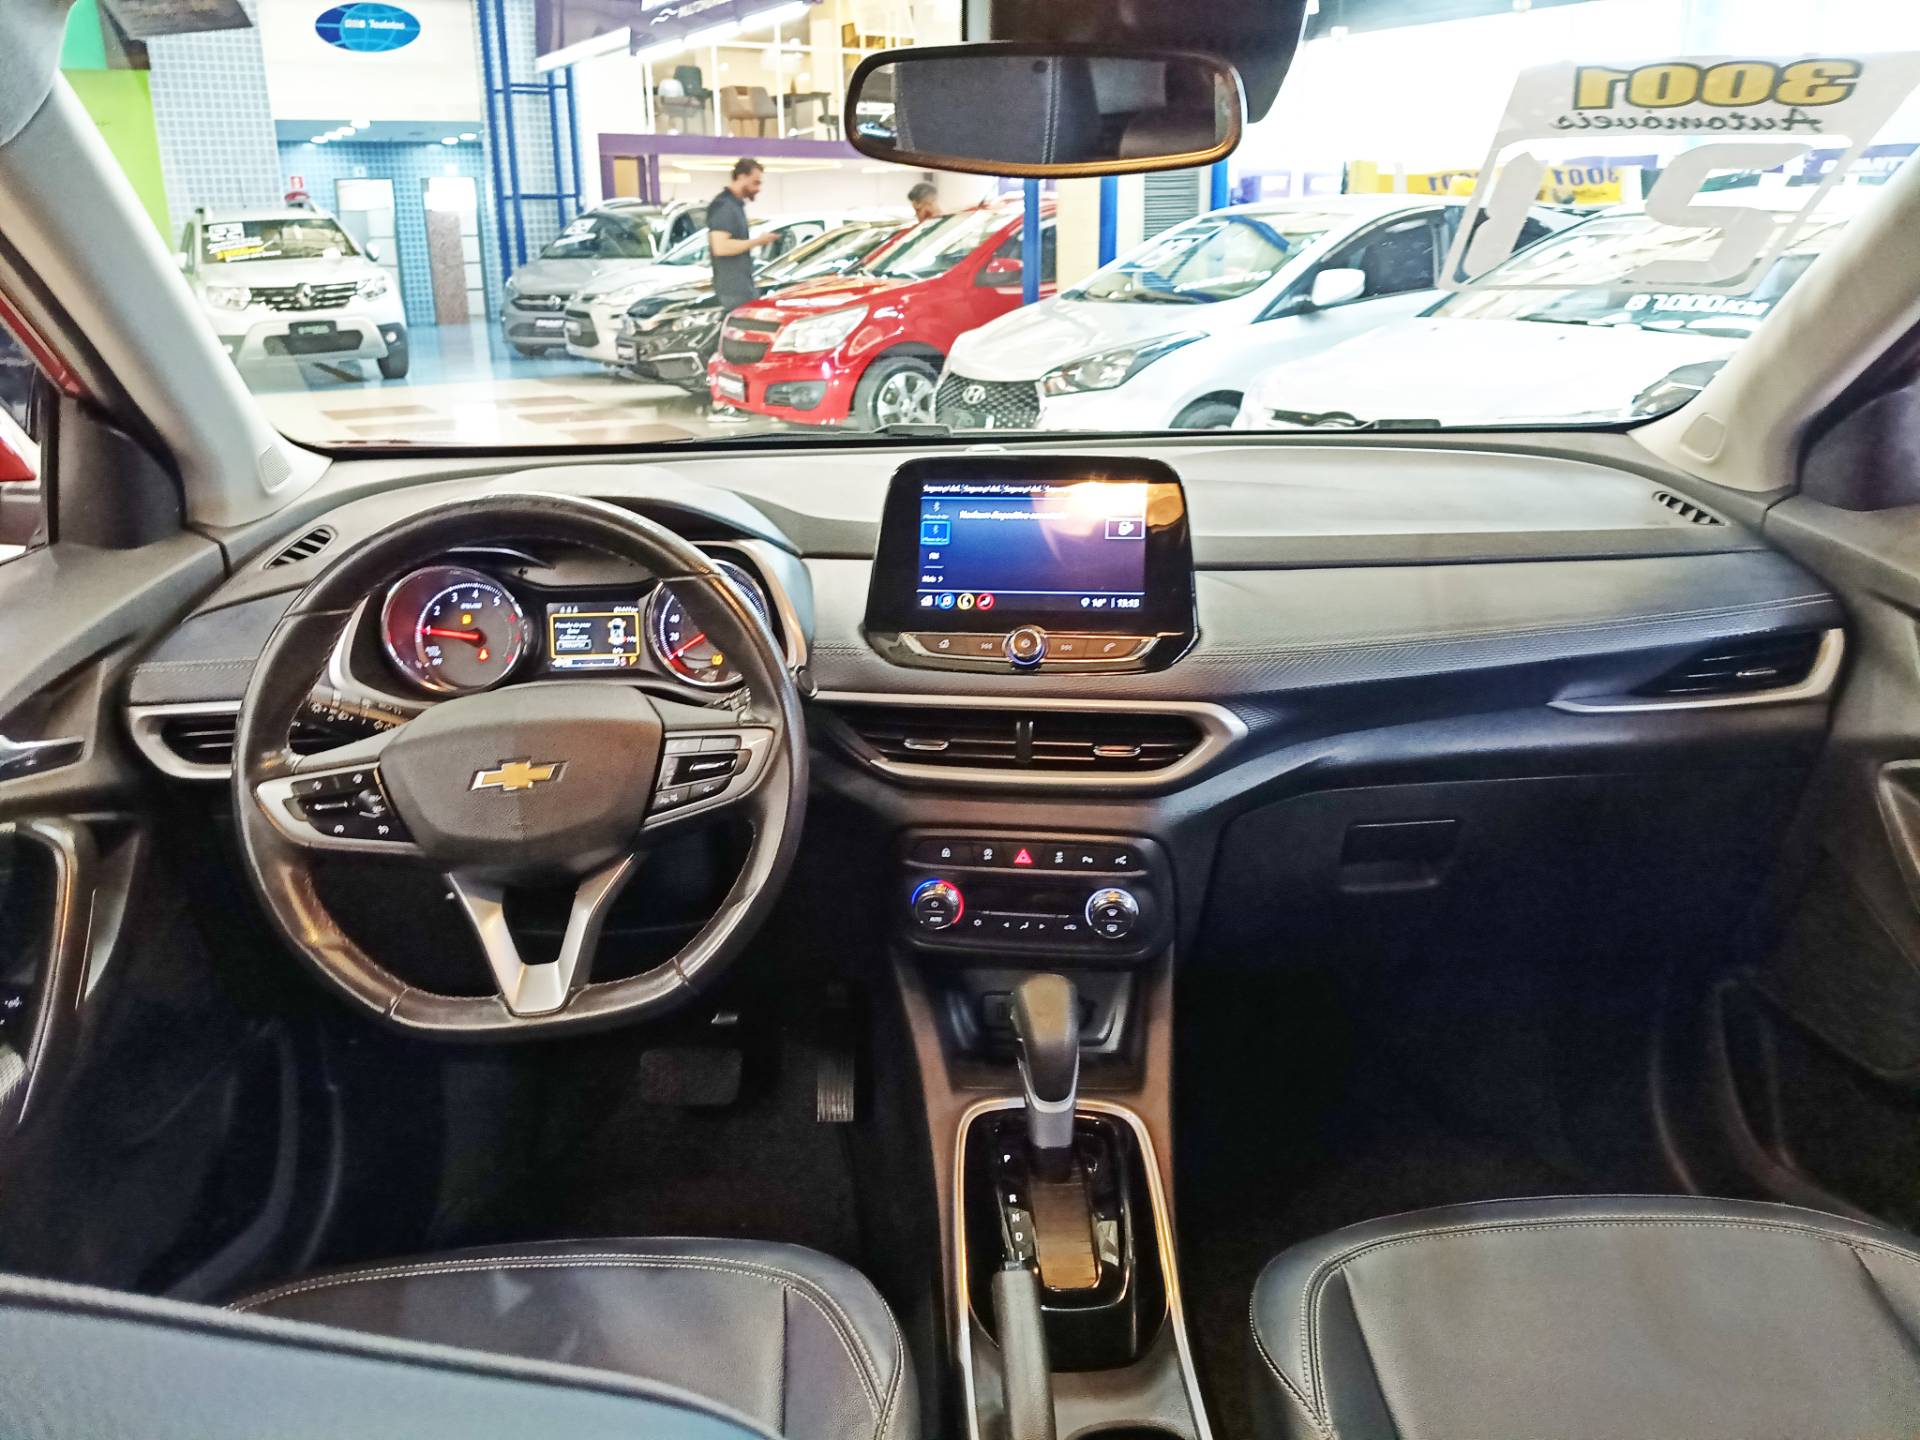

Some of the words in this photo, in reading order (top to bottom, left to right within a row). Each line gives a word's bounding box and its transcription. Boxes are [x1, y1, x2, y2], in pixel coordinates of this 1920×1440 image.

[451, 592, 459, 602] 3
[472, 589, 479, 599] 4
[433, 606, 441, 616] 2
[1003, 1154, 1011, 1163] P
[1009, 1194, 1017, 1203] R
[1012, 1213, 1020, 1222] N
[1015, 1232, 1023, 1241] D
[1018, 1251, 1025, 1261] L
